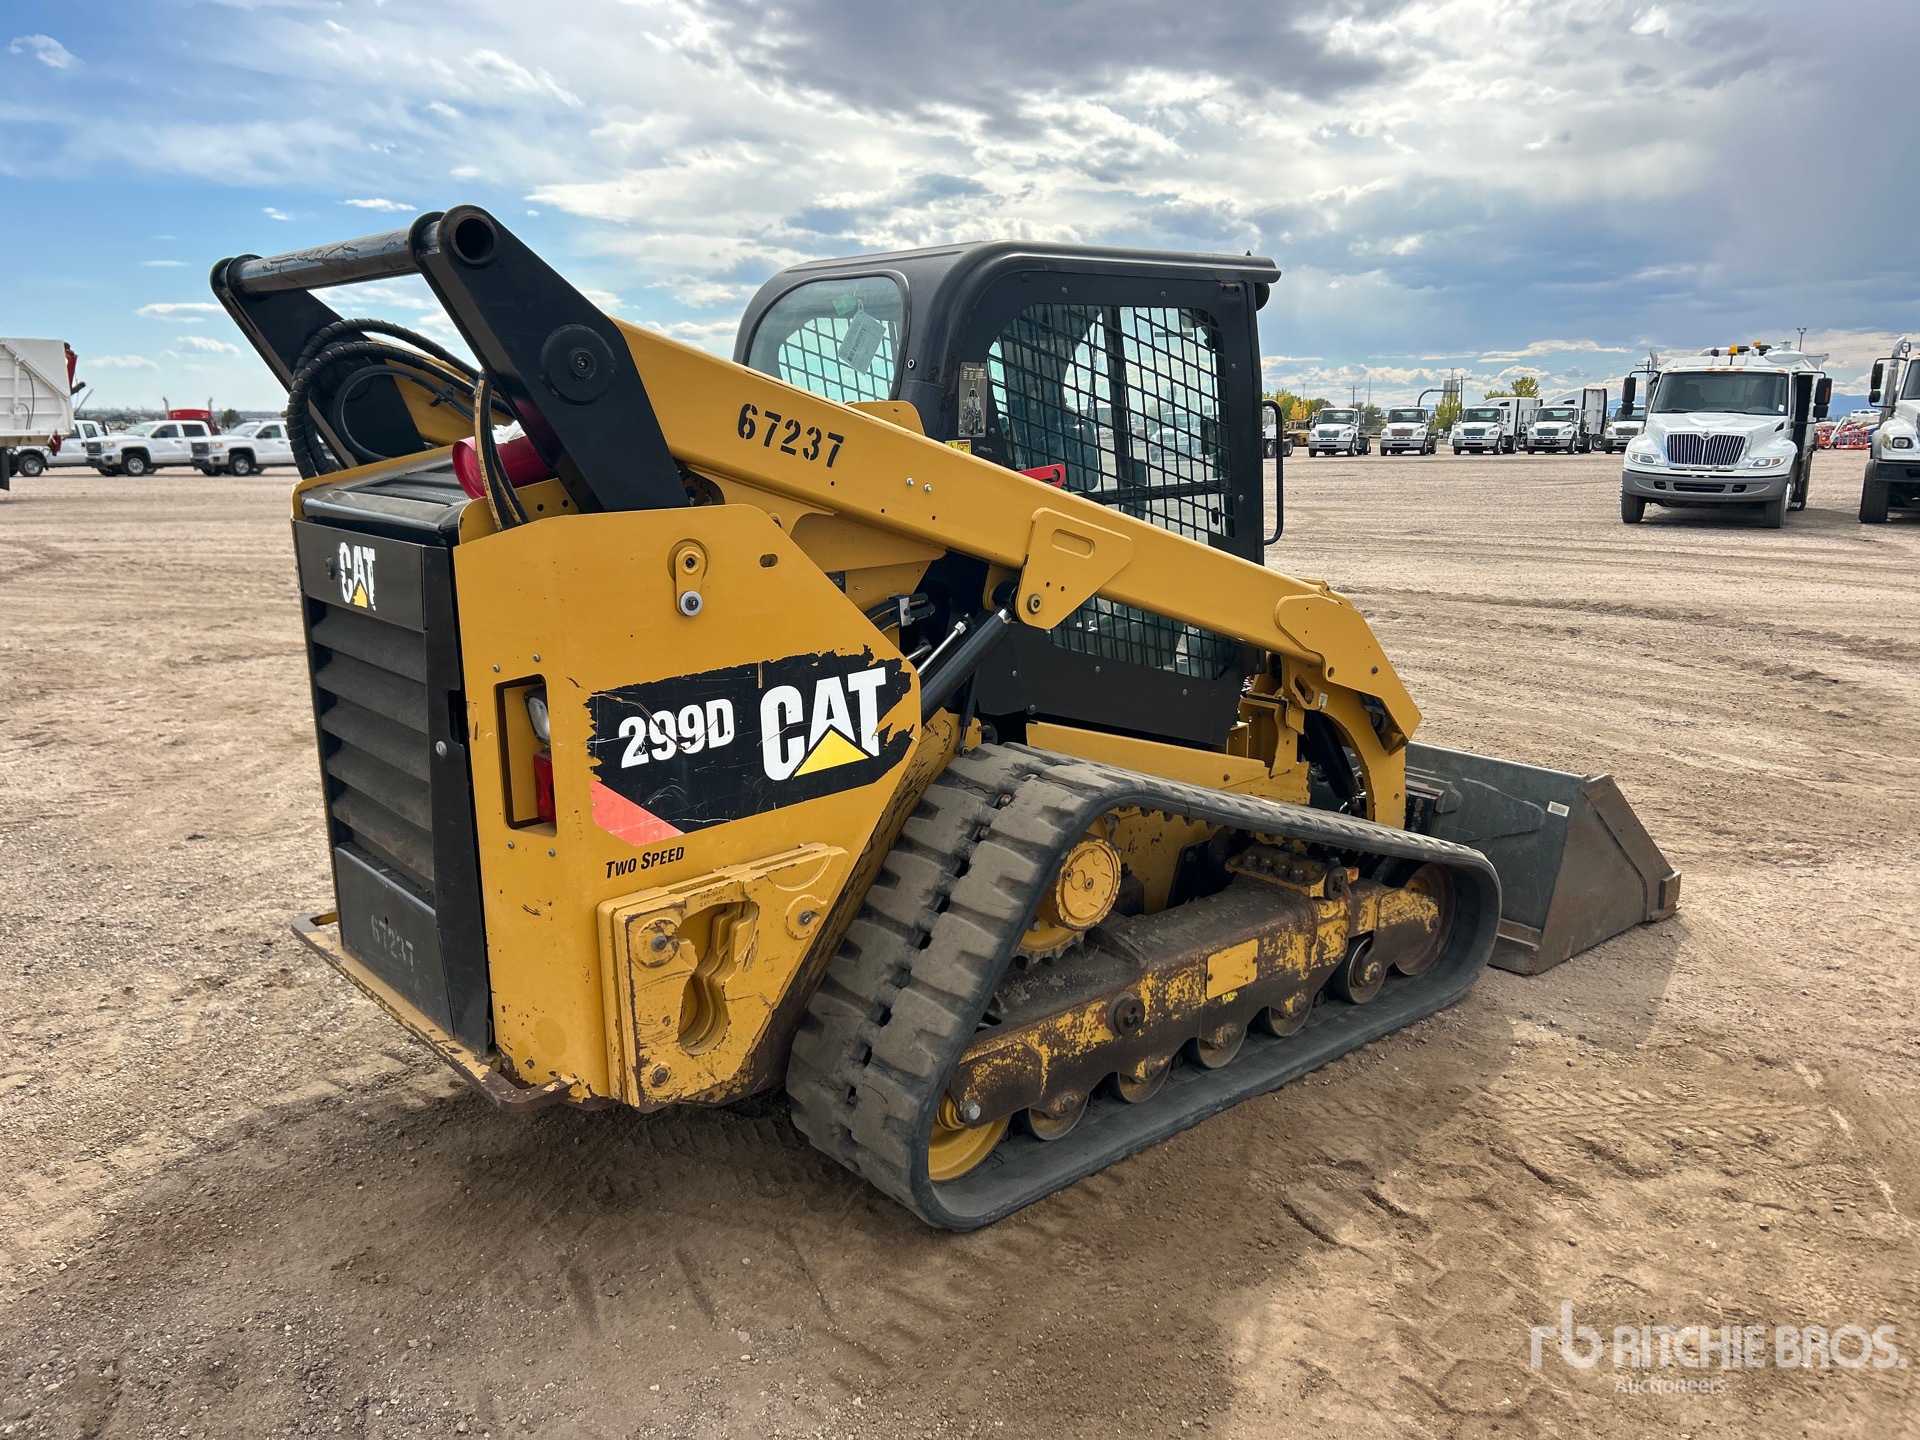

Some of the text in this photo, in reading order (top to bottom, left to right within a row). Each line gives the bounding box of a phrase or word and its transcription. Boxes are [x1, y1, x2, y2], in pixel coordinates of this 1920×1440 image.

[737, 402, 845, 469] 67237
[339, 541, 377, 612] CAT
[618, 666, 887, 782] 299D CAT
[370, 914, 415, 972] 67237
